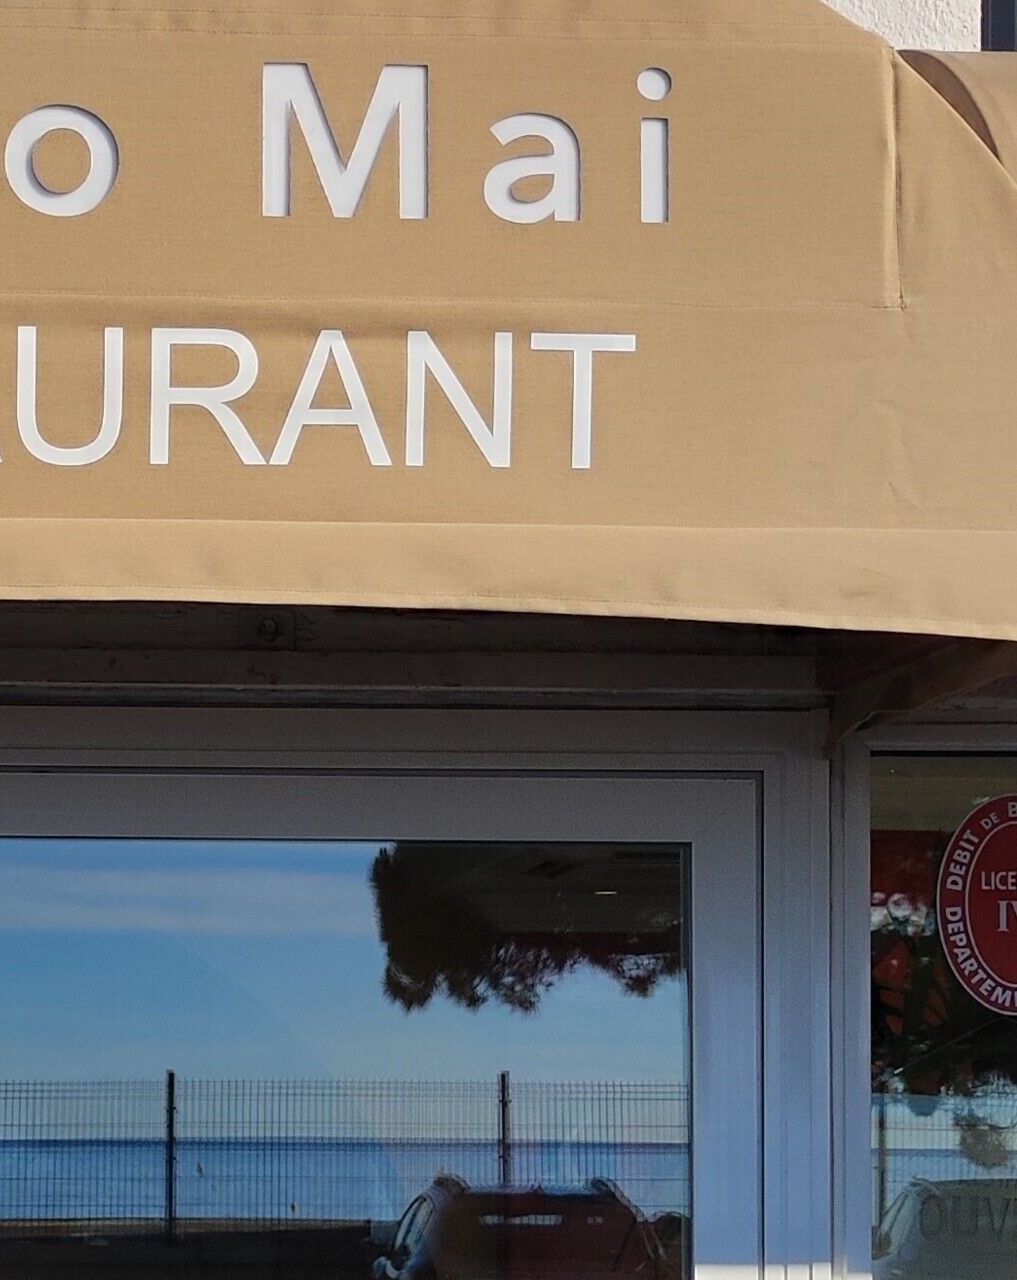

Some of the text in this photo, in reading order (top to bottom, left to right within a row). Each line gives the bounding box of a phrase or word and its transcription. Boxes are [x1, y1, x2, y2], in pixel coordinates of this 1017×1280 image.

[262, 62, 672, 224] Mai
[945, 829, 979, 891] DEBIT
[979, 812, 1000, 830] DE
[981, 871, 1017, 890] LICE
[945, 906, 1017, 1007] DEPARTEM
[920, 1194, 1017, 1241] OUV
